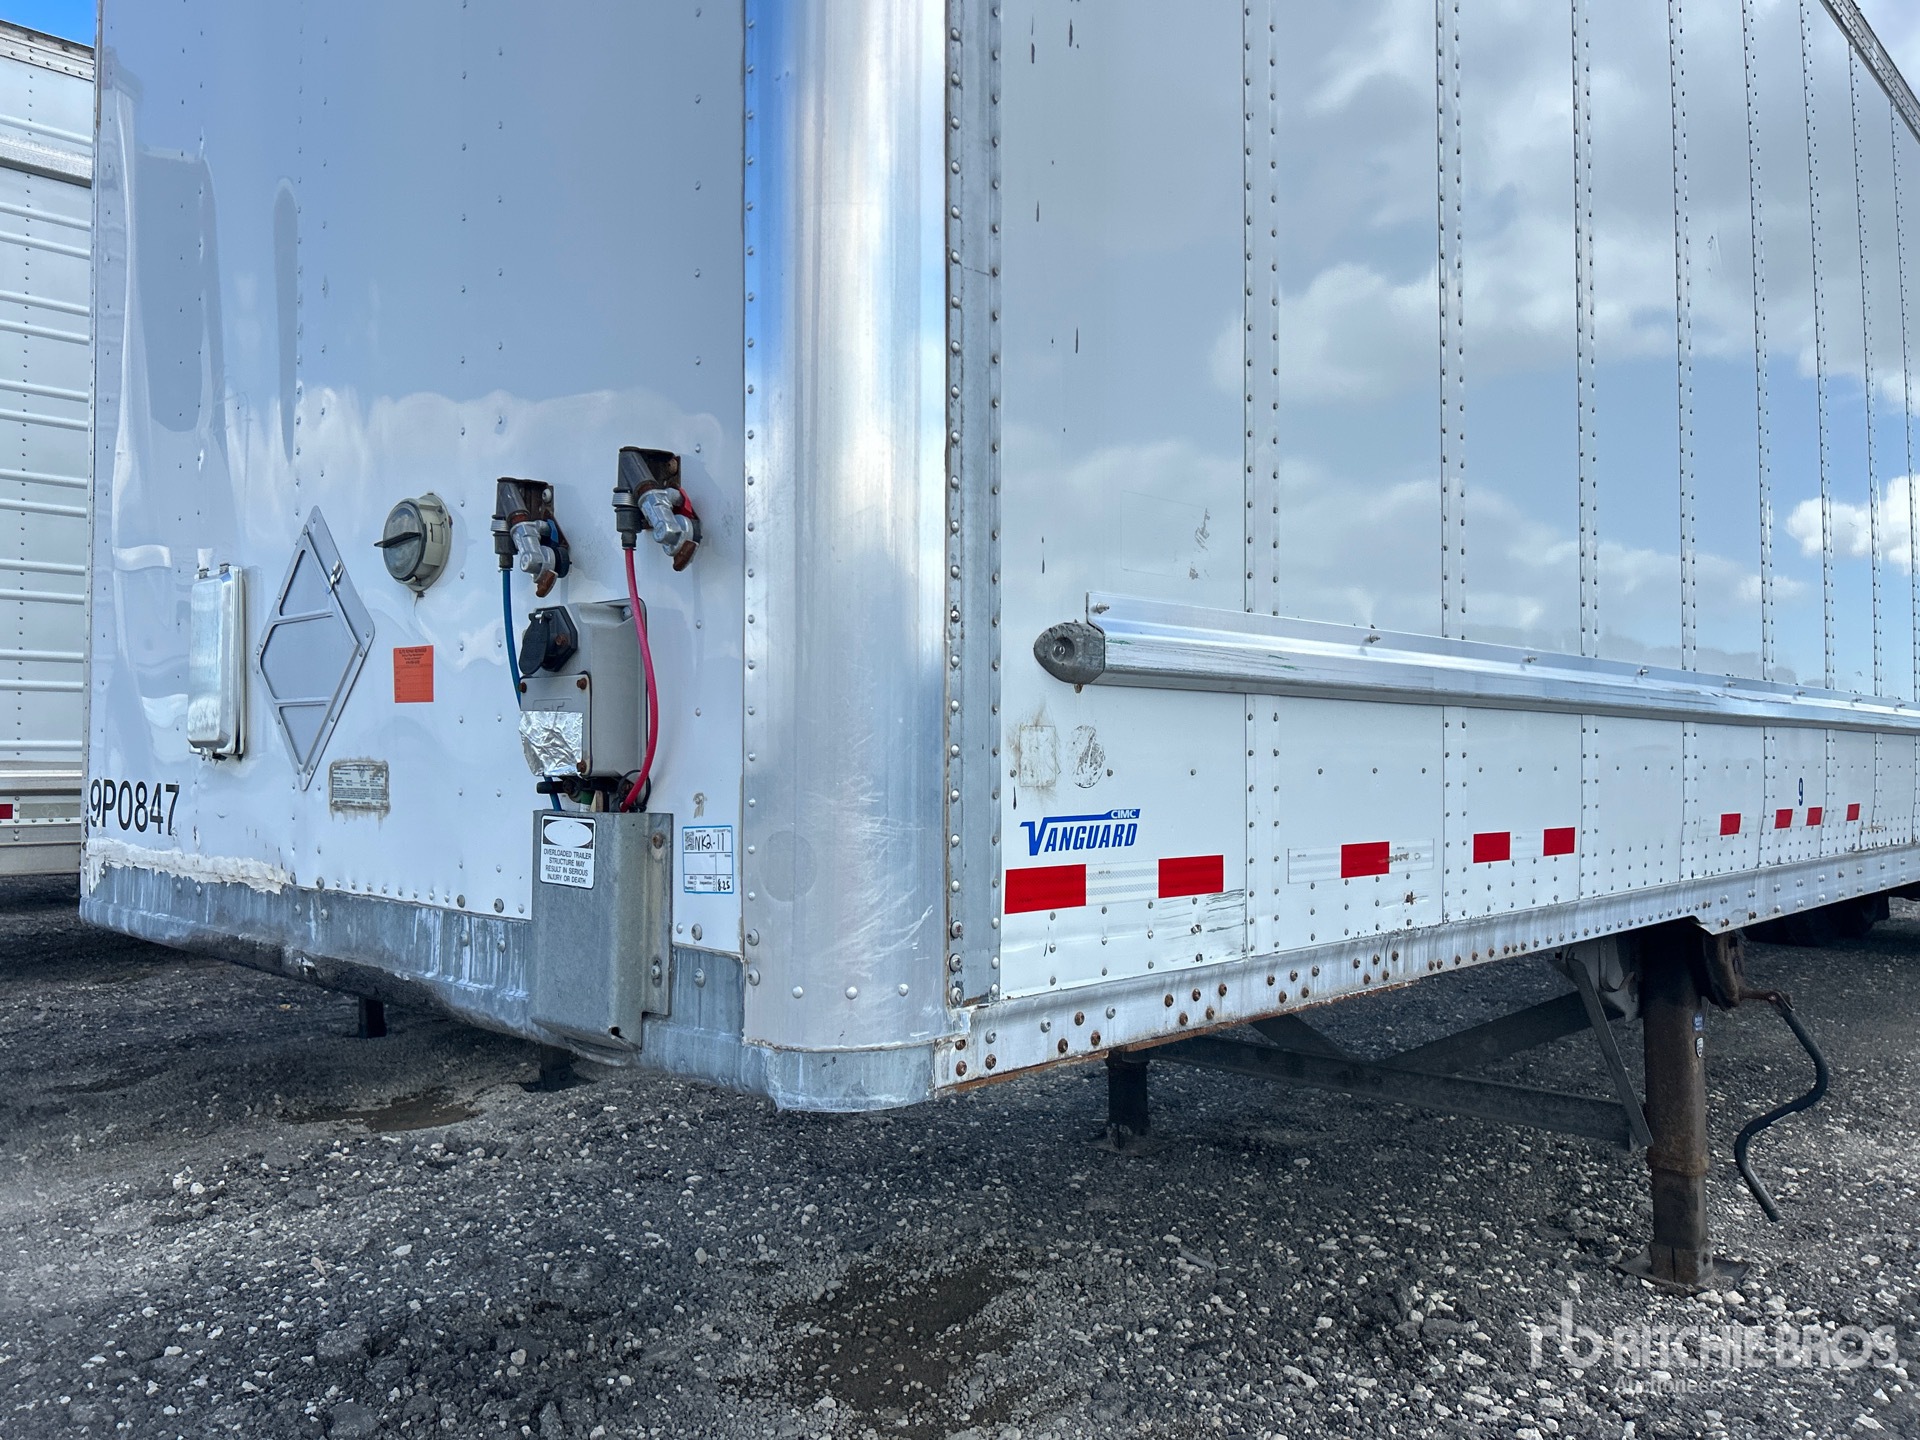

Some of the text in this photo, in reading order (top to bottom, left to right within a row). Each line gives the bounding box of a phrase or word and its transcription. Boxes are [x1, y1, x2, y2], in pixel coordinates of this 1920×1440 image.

[1798, 777, 1804, 807] 9
[90, 779, 180, 836] 9P0847
[1110, 809, 1137, 819] CIMC
[1019, 817, 1138, 856] VANGUARD
[543, 848, 592, 860] OVERLOADED TRAILER
[548, 857, 586, 868] STRUCTURE MAY
[545, 865, 562, 873] RESULT
[568, 867, 589, 877] SERIOUS
[547, 873, 563, 881] INJURY
[571, 876, 587, 884] DEATH
